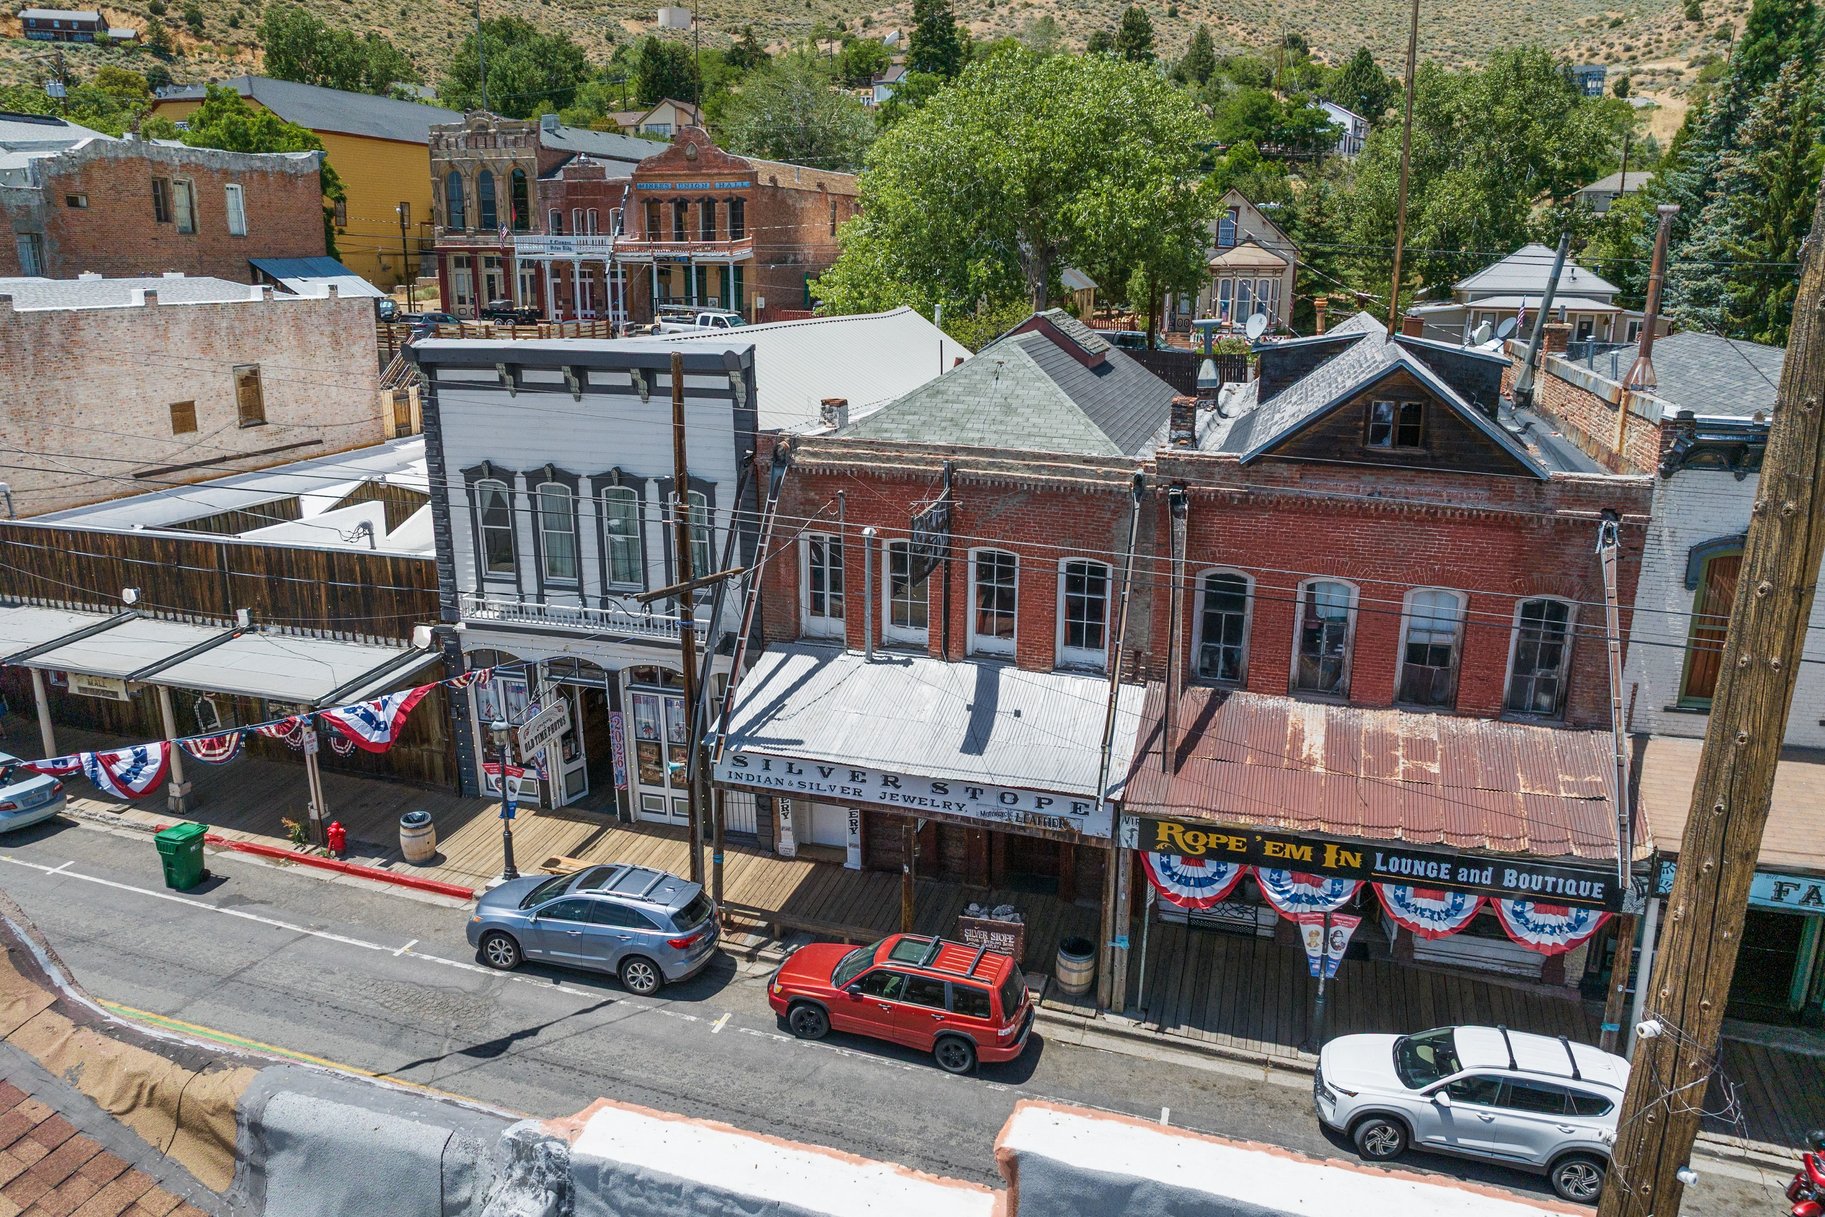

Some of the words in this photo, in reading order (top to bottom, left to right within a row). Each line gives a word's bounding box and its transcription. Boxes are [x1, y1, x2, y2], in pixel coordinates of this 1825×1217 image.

[678, 182, 709, 190] UNION
[719, 181, 747, 189] HALL
[524, 738, 535, 753] OLD
[534, 727, 548, 746] TIME
[546, 714, 567, 737] PHOTOS
[614, 717, 625, 768] 2026
[728, 770, 784, 786] INDIAN
[797, 780, 863, 797] SILVER
[732, 755, 902, 788] SILVER
[931, 781, 1090, 816] STOPE
[1155, 821, 1248, 855] ROPE
[1321, 843, 1363, 868] IN
[1374, 852, 1451, 880] LOUNGE
[1457, 866, 1493, 885] and
[1502, 868, 1605, 899] BOUTIQUE
[1770, 880, 1825, 908] FA
[964, 928, 988, 940] SILVER
[990, 931, 1015, 944] STOPE
